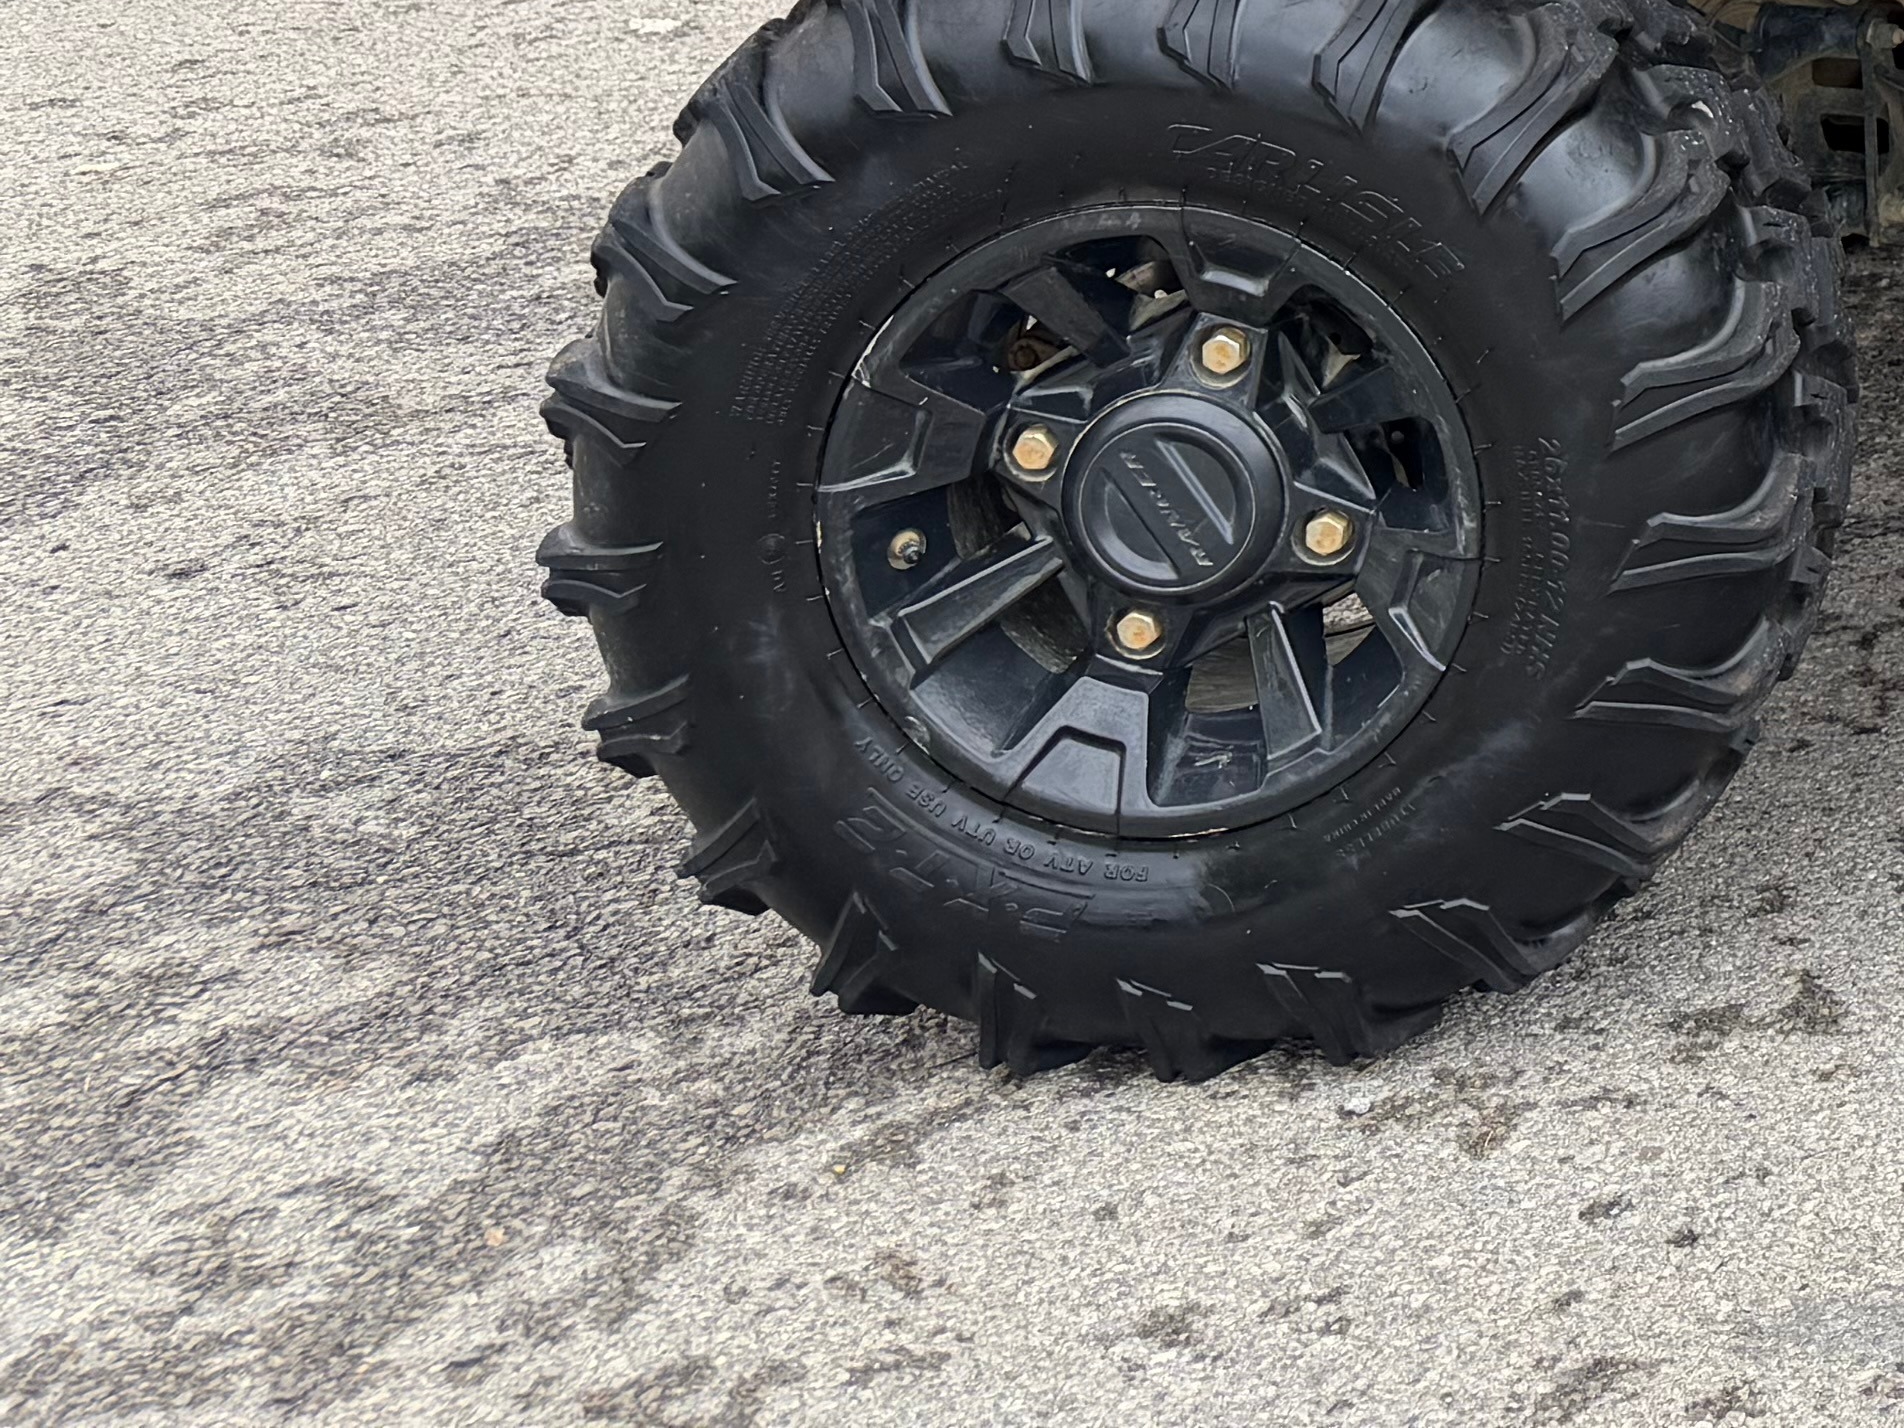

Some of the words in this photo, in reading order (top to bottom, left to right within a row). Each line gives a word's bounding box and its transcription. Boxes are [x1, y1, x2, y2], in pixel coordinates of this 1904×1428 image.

[1119, 450, 1214, 567] RANGER
[852, 735, 906, 785] ONLY
[904, 782, 947, 819] USE
[951, 814, 998, 847] UTV
[1002, 837, 1036, 863] OR
[1043, 855, 1094, 877] ATV
[1104, 862, 1150, 883] FOR
